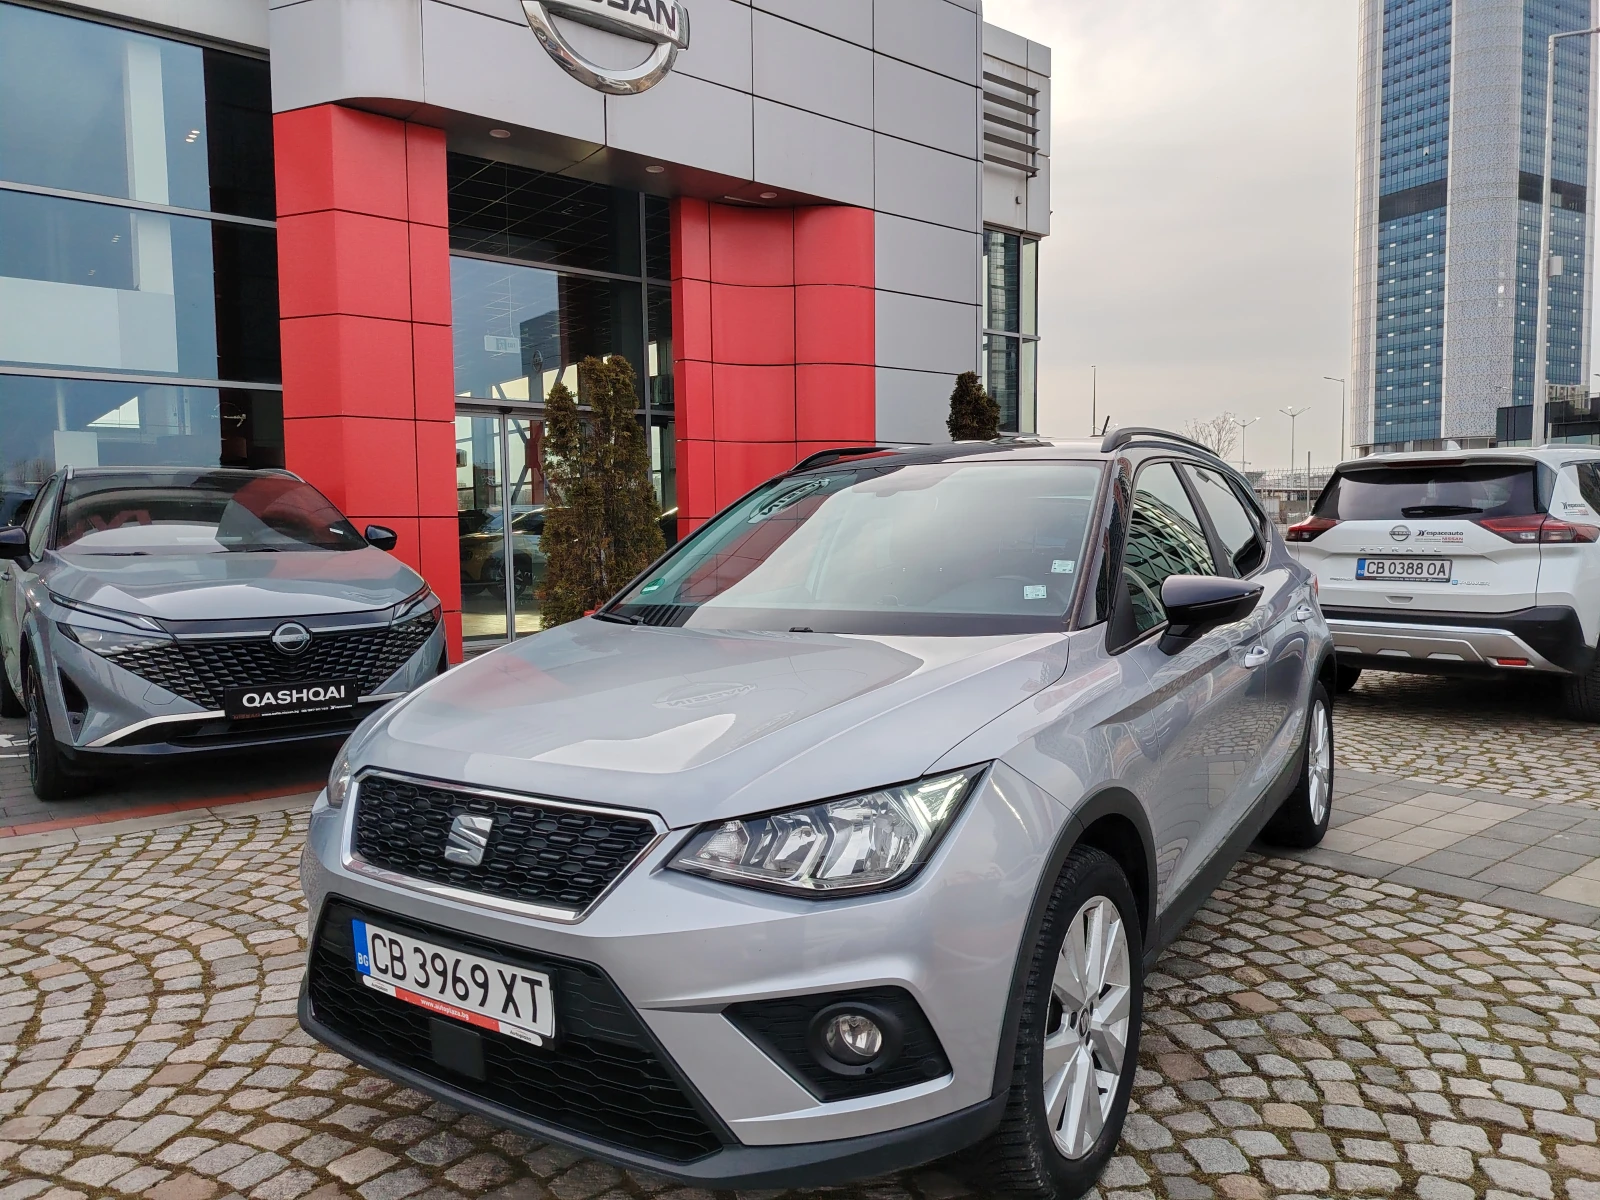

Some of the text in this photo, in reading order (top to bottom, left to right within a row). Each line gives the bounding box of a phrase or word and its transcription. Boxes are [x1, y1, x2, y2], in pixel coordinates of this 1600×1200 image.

[1366, 562, 1385, 575] CB
[1388, 562, 1424, 576] 0388
[242, 685, 345, 707] QASHQAI
[357, 932, 543, 1024] BG CB 3969 XT
[420, 999, 469, 1021] www.autoplaza.bg
